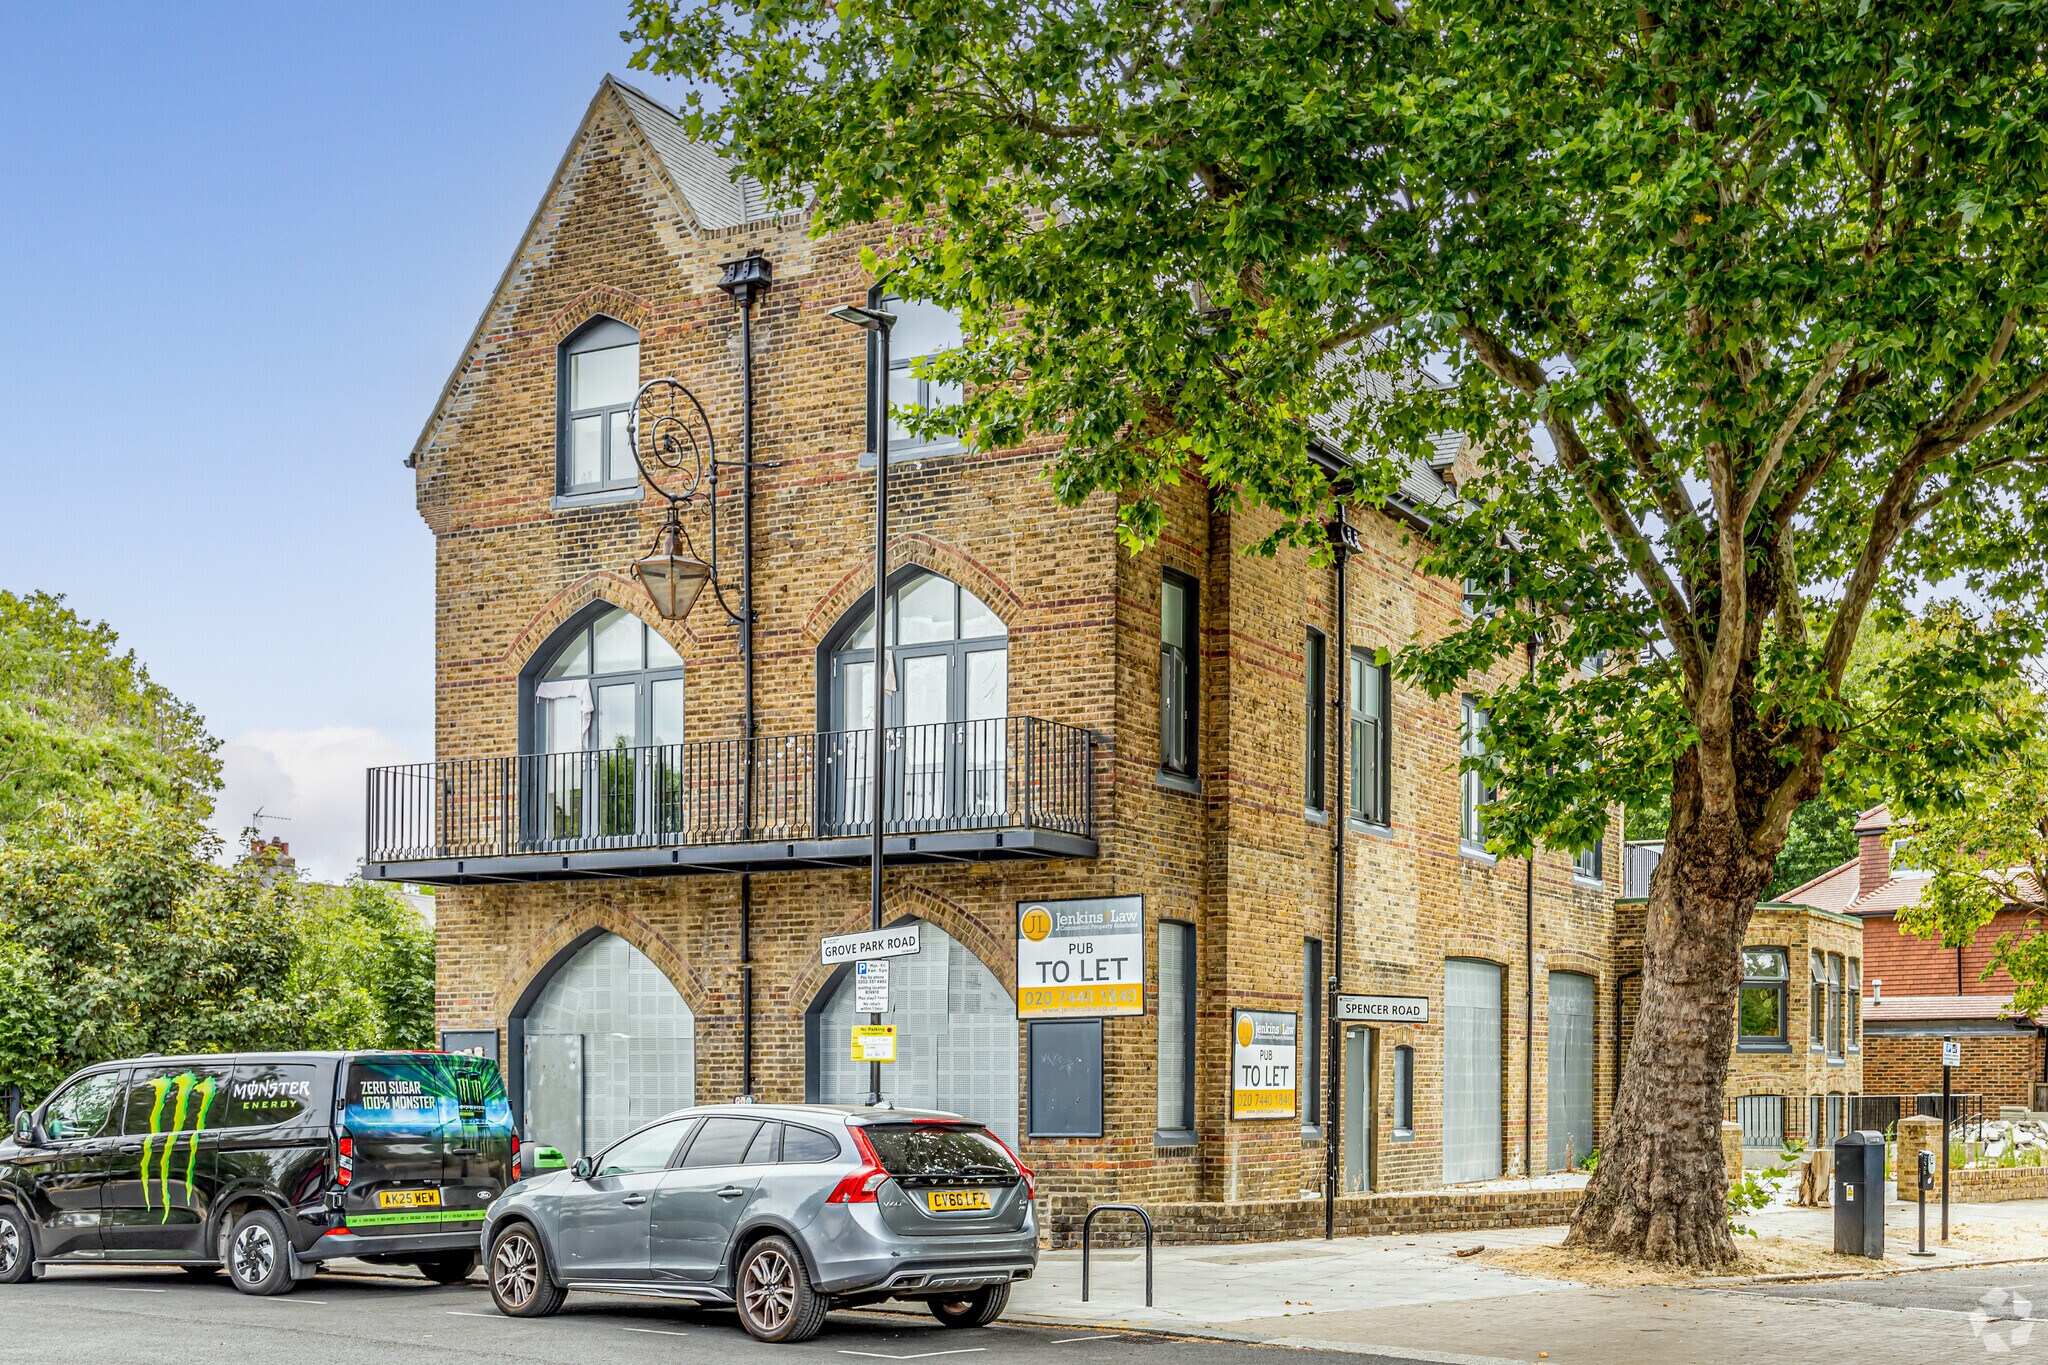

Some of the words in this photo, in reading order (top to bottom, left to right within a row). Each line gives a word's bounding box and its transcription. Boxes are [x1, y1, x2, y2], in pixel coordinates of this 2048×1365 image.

[1024, 915, 1048, 934] JL
[1055, 911, 1103, 931] Jenkins
[1110, 909, 1138, 923] Law
[1060, 924, 1091, 932] Commercial
[1091, 923, 1113, 931] Property
[825, 943, 857, 957] GROVE
[860, 939, 885, 953] PARK
[887, 936, 916, 949] ROAD
[1068, 942, 1094, 955] PUB
[1035, 960, 1070, 984] TO
[1080, 957, 1128, 982] LET
[1025, 991, 1053, 1006] 020
[1058, 989, 1094, 1005] 7440
[1100, 987, 1137, 1003] 1840
[1042, 1006, 1118, 1014] www.jenkinslaw.co.uk
[1345, 1003, 1389, 1015] SPENCER
[1392, 1005, 1421, 1016] ROAD
[1254, 1021, 1280, 1040] Jenkins
[1282, 1023, 1295, 1035] Law
[1259, 1049, 1273, 1061] PUB
[1241, 1065, 1261, 1087] TO
[1265, 1065, 1289, 1087] LET
[360, 1081, 387, 1095] ZERO
[388, 1080, 422, 1095] SUGAR
[242, 1100, 297, 1110] ENERGY
[362, 1096, 391, 1110] 100%
[392, 1095, 436, 1110] MONSTER
[1237, 1094, 1253, 1107] 020
[1255, 1093, 1272, 1106] 7440
[1275, 1093, 1292, 1106] 1840
[385, 1193, 413, 1205] AK25
[414, 1192, 435, 1203] WEW
[934, 1193, 966, 1207] CV66
[966, 1192, 988, 1206] LFZ
